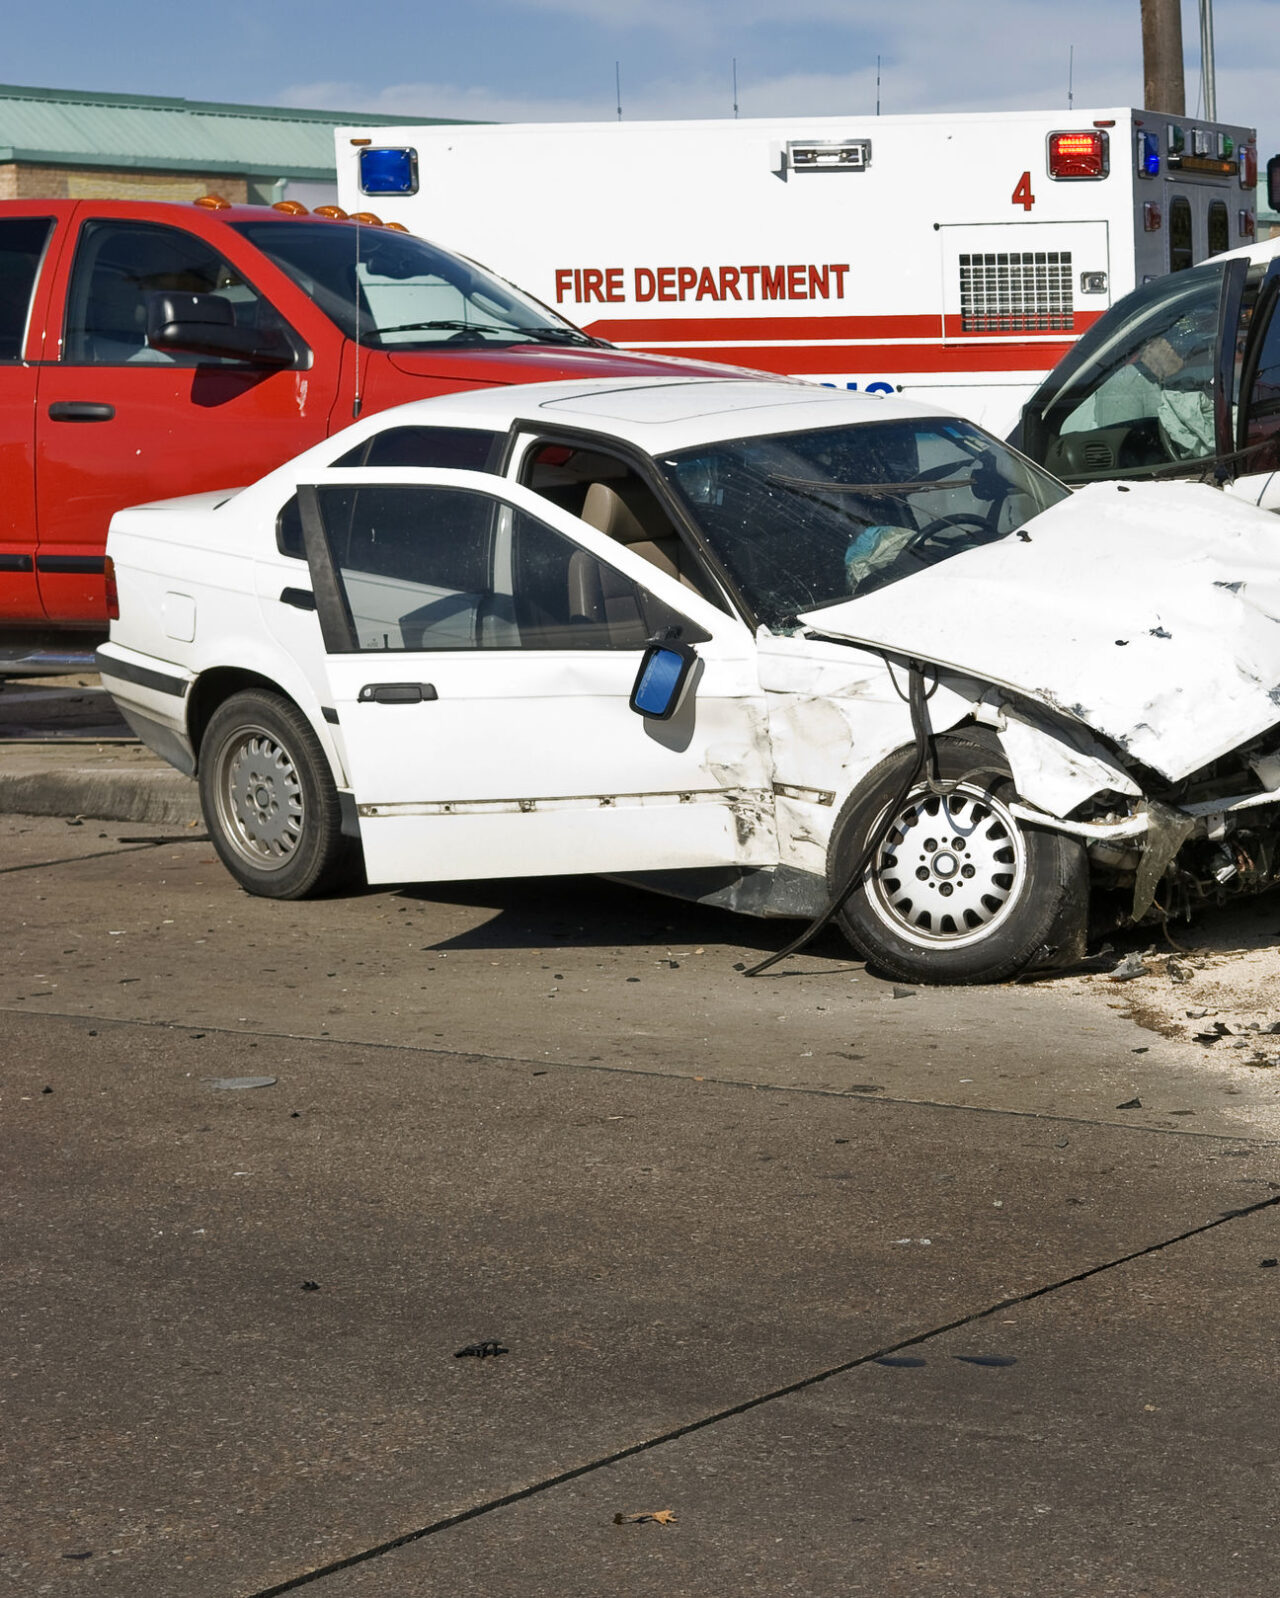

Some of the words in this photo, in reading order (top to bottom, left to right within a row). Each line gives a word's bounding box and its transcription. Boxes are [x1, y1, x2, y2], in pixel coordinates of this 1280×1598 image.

[1011, 172, 1036, 211] 4
[555, 268, 626, 303] FIRE
[635, 264, 850, 302] DEPARTMENT
